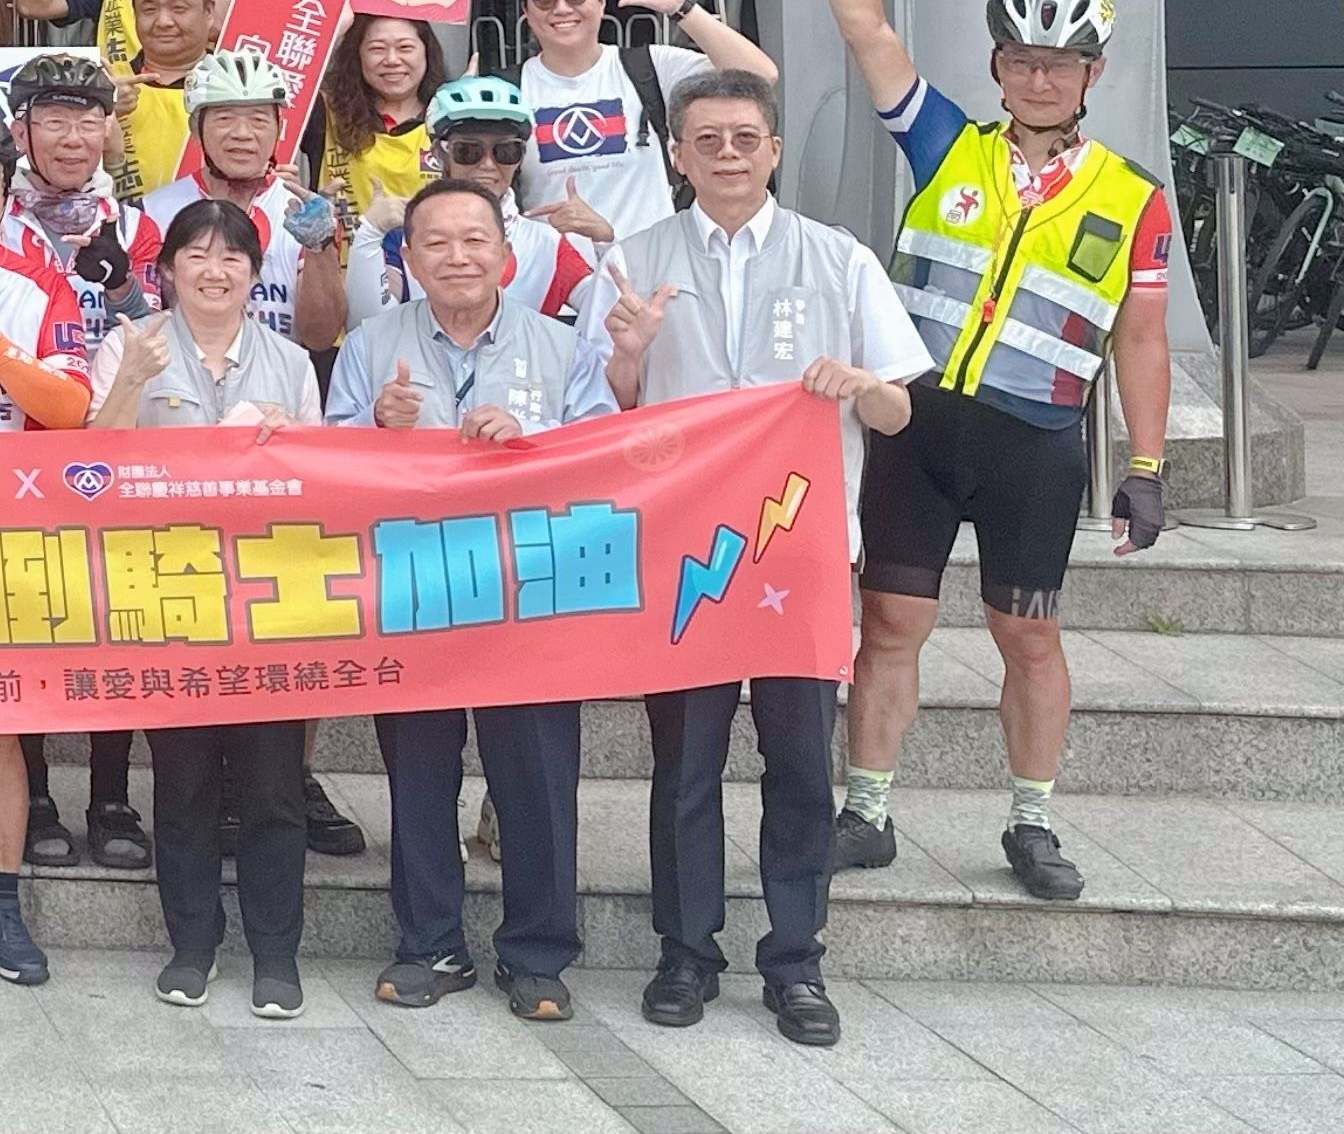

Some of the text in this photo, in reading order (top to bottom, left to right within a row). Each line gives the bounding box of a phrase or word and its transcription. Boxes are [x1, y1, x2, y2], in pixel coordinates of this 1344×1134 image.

[772, 297, 794, 360] 林建宏
[118, 465, 172, 479] 財團法人
[118, 477, 304, 499] 全聯慶祥慈善事業基金會
